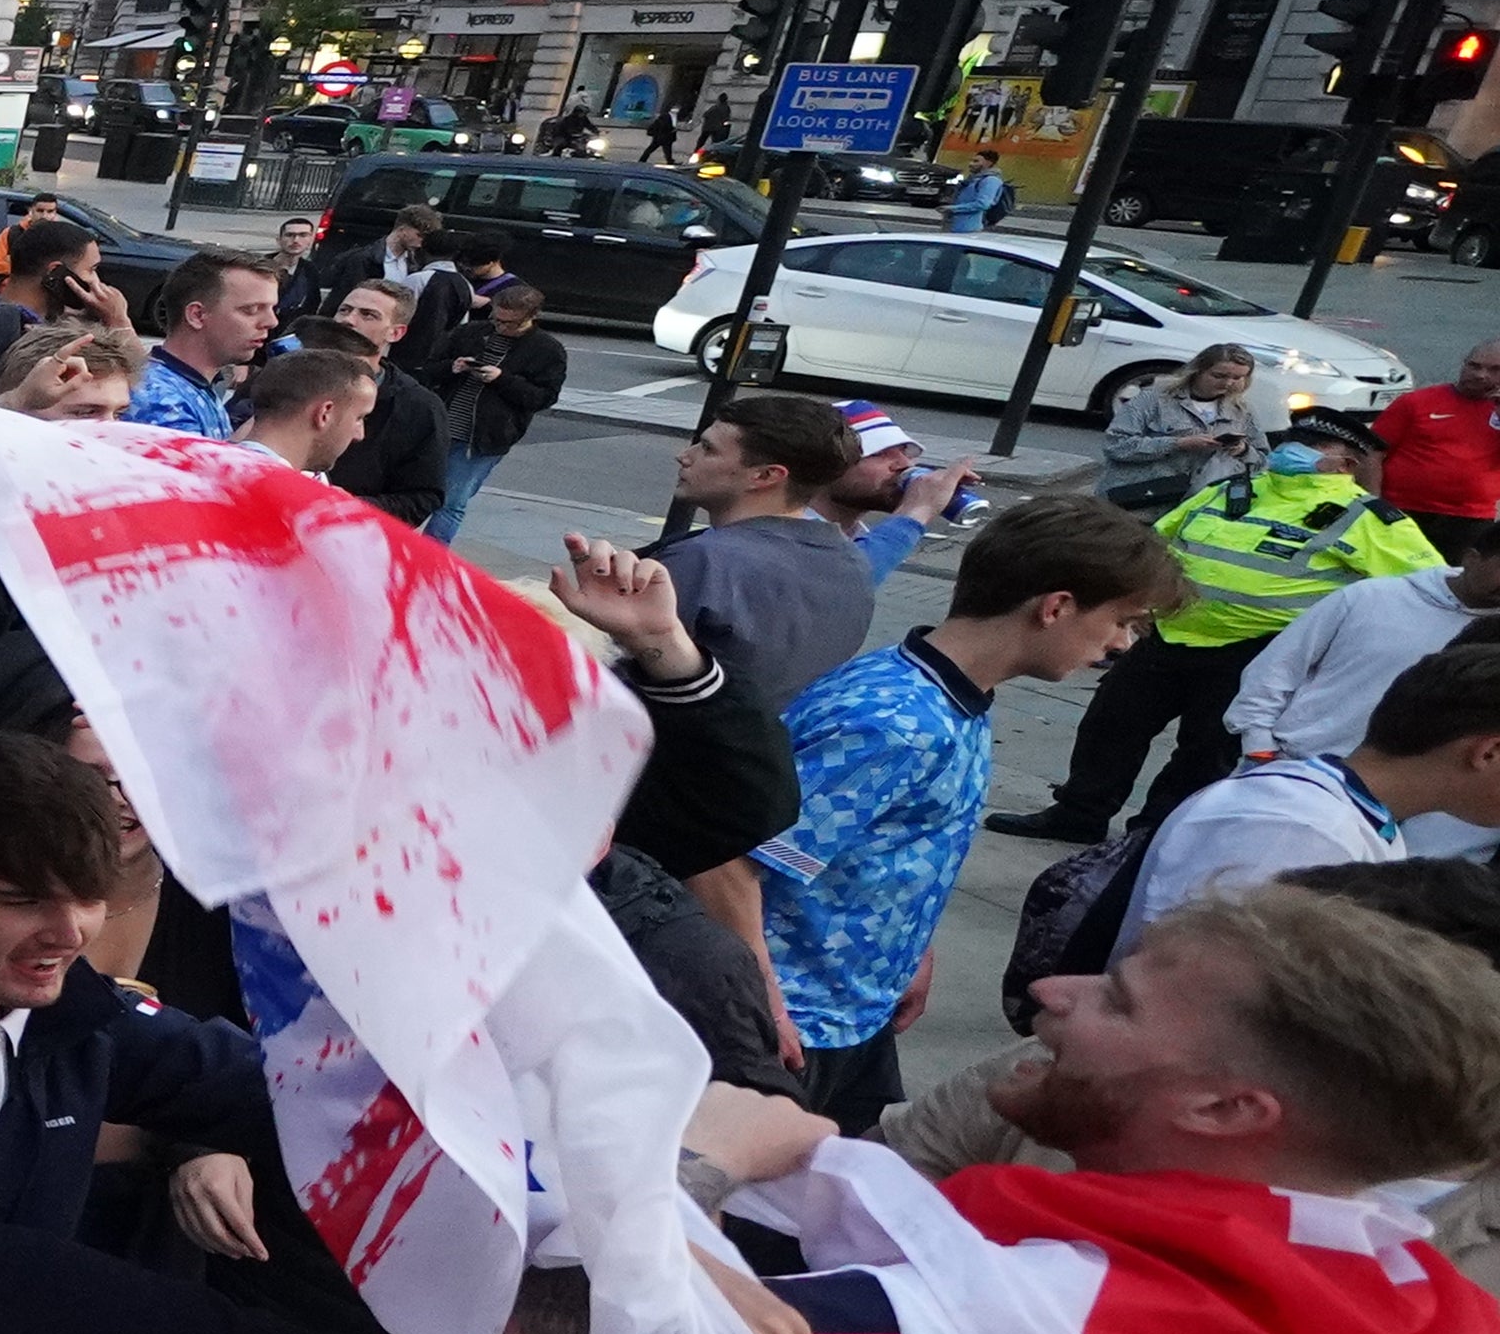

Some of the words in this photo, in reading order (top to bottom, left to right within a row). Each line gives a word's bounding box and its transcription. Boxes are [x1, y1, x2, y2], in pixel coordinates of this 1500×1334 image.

[466, 12, 516, 27] NESPRESSO
[630, 9, 695, 27] NESPRESSO
[307, 74, 368, 83] UNDERGROUND
[798, 69, 840, 82] BUS
[845, 71, 900, 83] LANE
[776, 115, 828, 128] LOOK
[835, 118, 892, 131] BOTH
